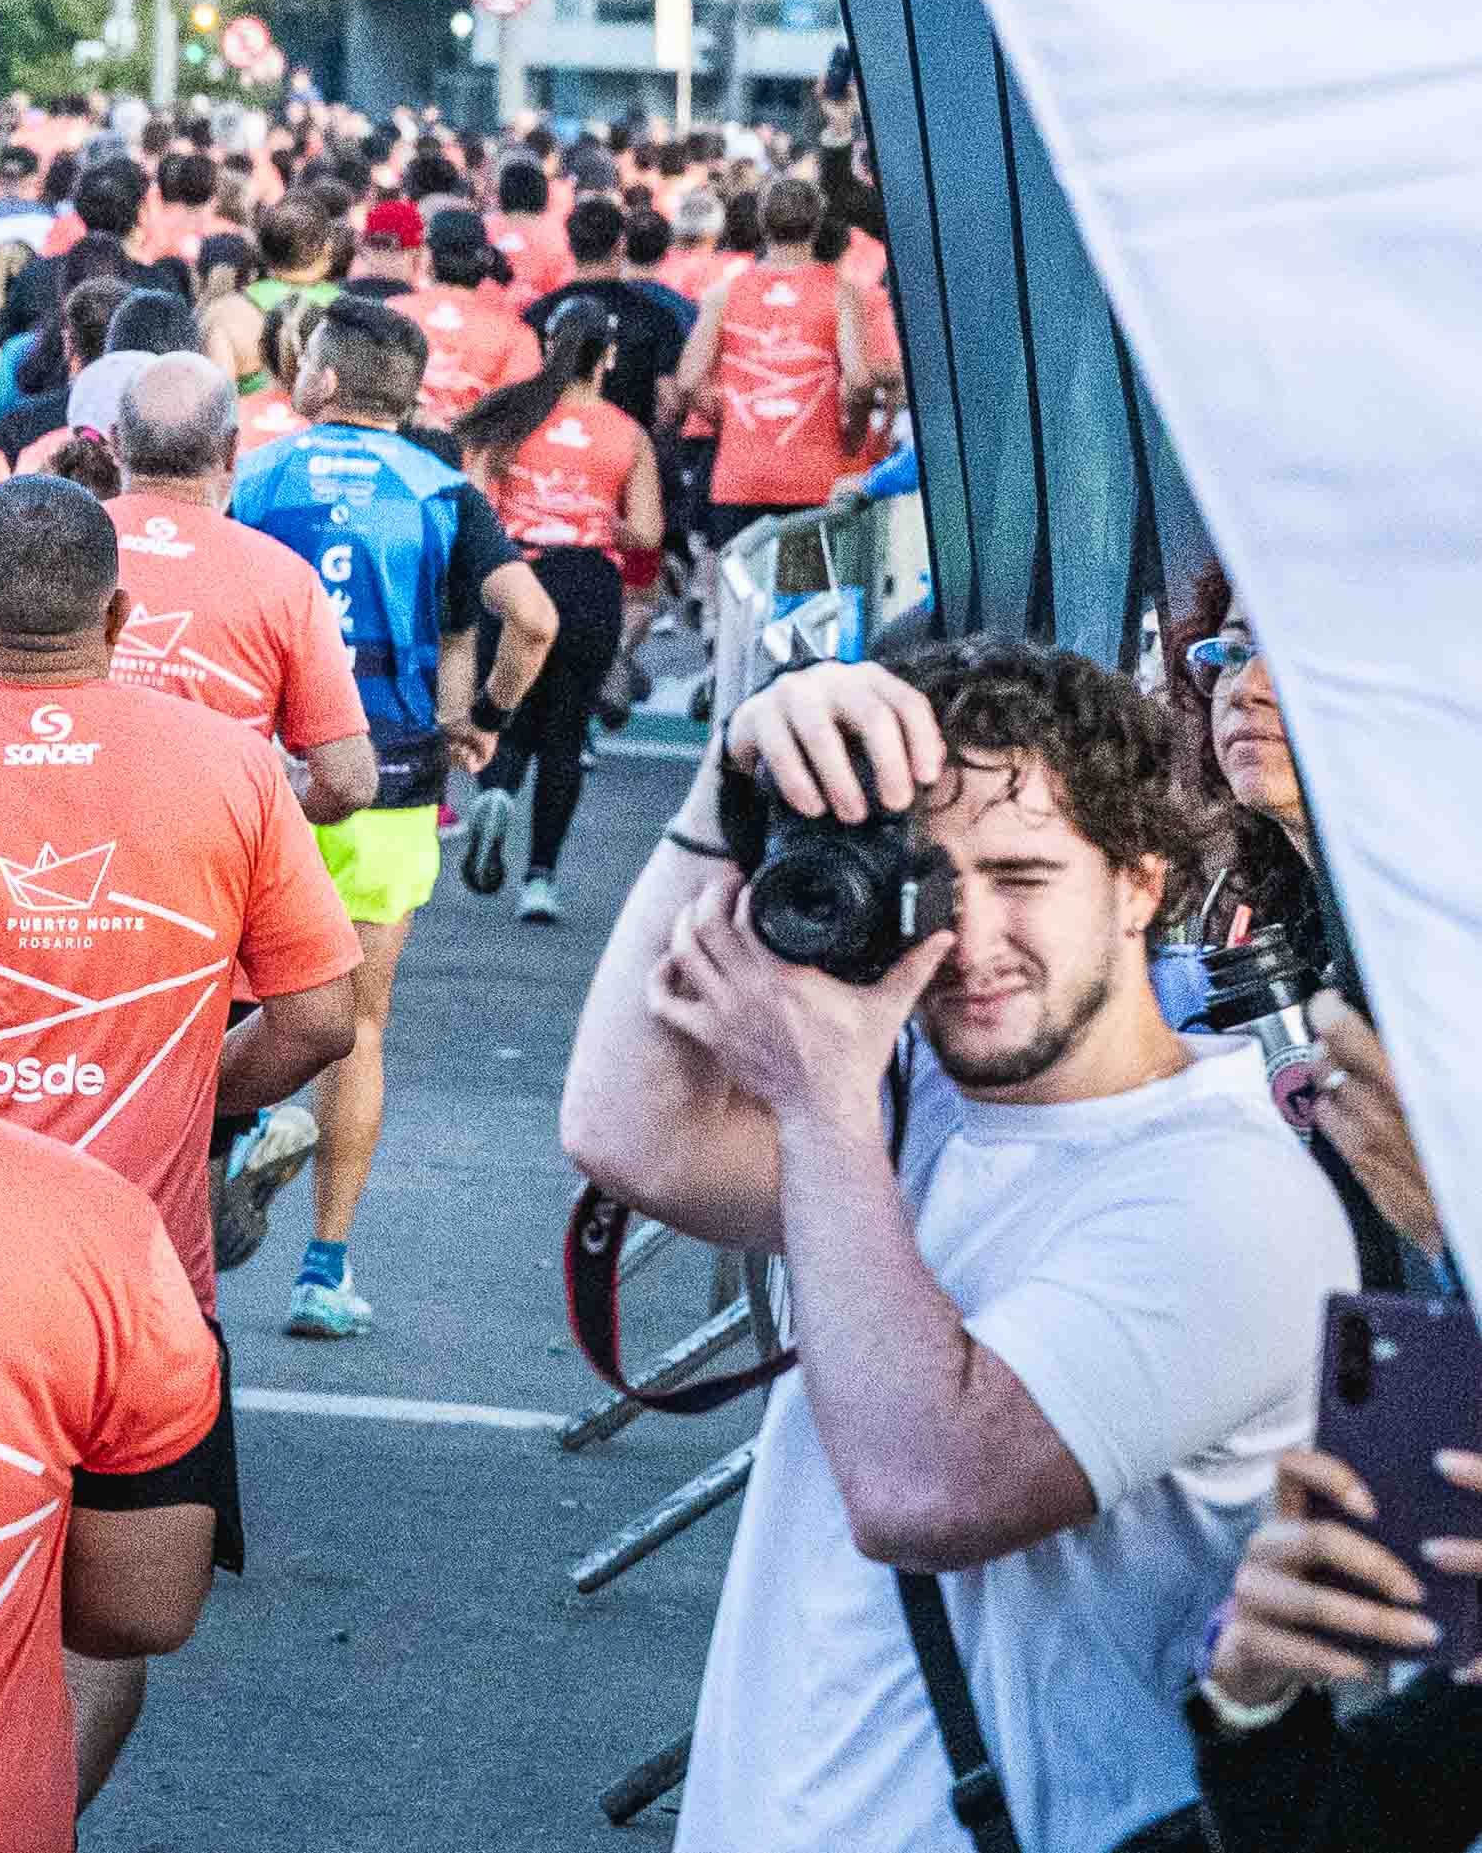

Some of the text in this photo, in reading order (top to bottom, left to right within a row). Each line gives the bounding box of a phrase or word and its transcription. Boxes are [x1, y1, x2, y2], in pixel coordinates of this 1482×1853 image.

[7, 917, 79, 932] PUERTO
[86, 917, 145, 932] NORTE
[19, 937, 91, 949] ROSARIO
